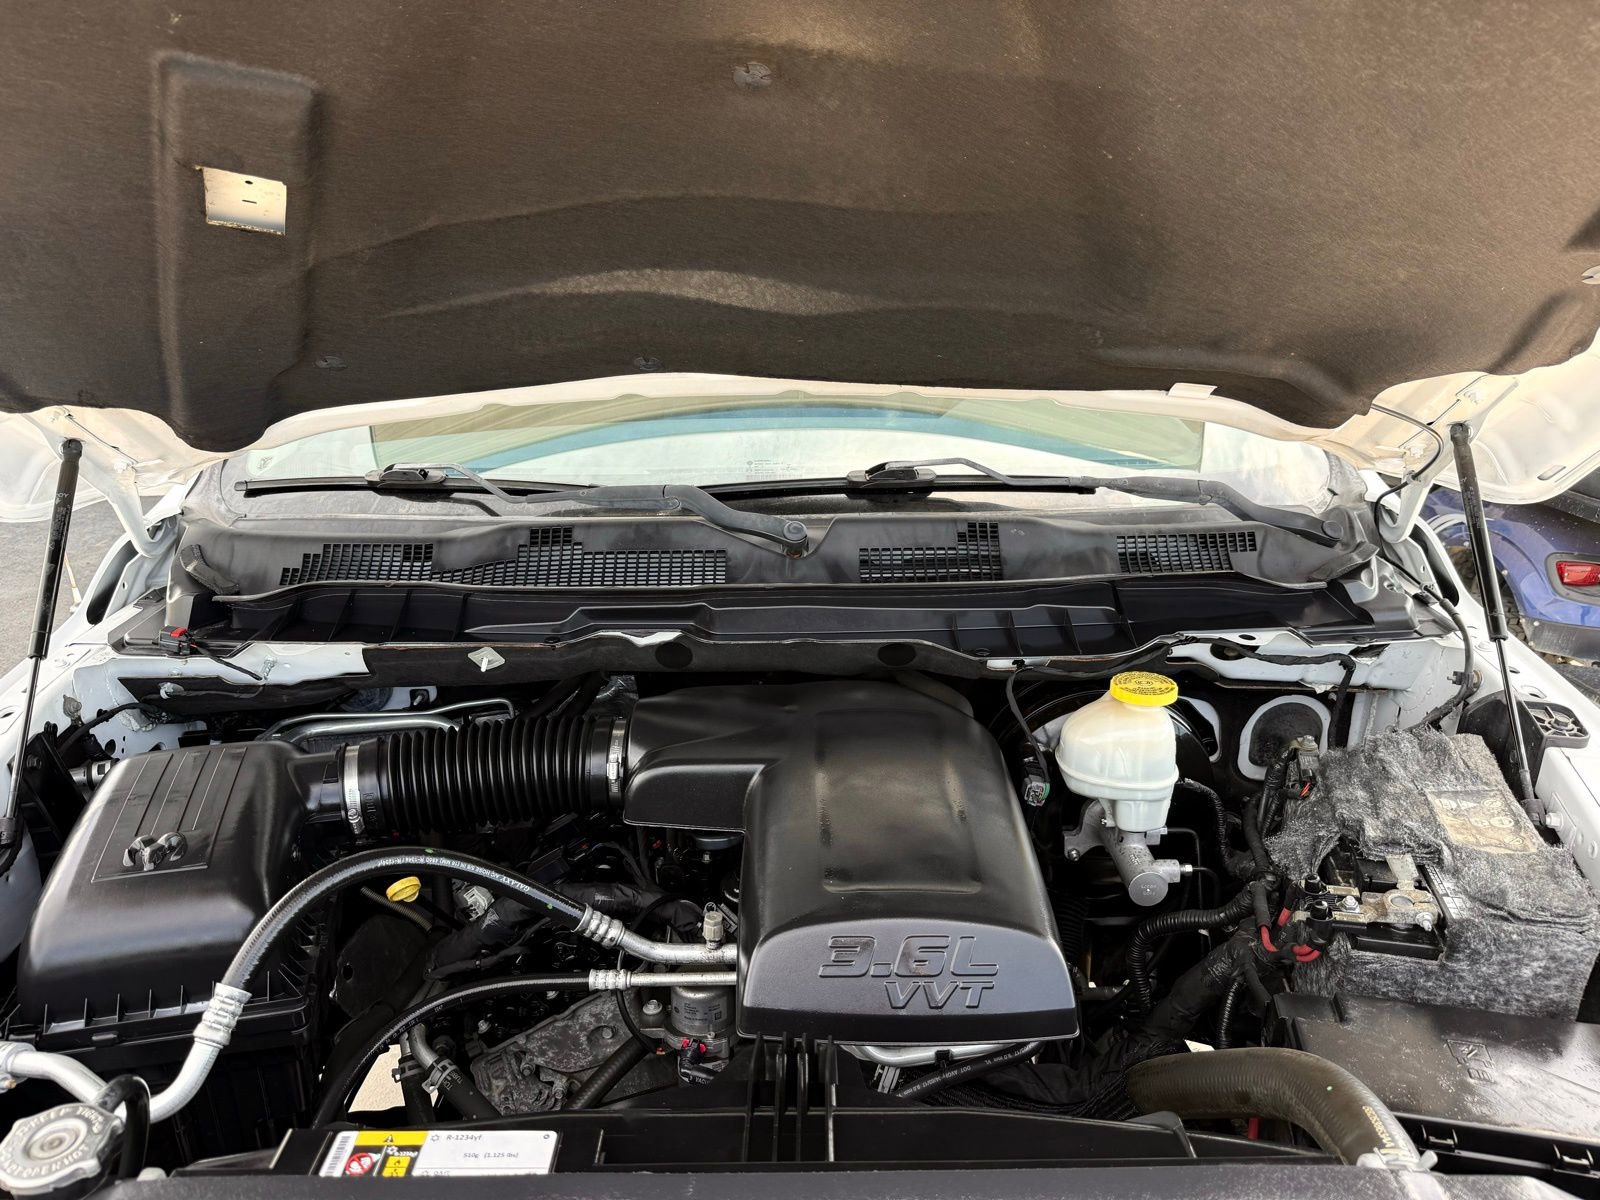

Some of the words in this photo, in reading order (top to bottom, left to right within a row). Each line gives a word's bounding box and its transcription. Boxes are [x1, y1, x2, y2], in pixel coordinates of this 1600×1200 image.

[500, 876, 530, 892] GALAXY
[818, 935, 999, 978] 3.6L
[884, 980, 995, 1009] VVT
